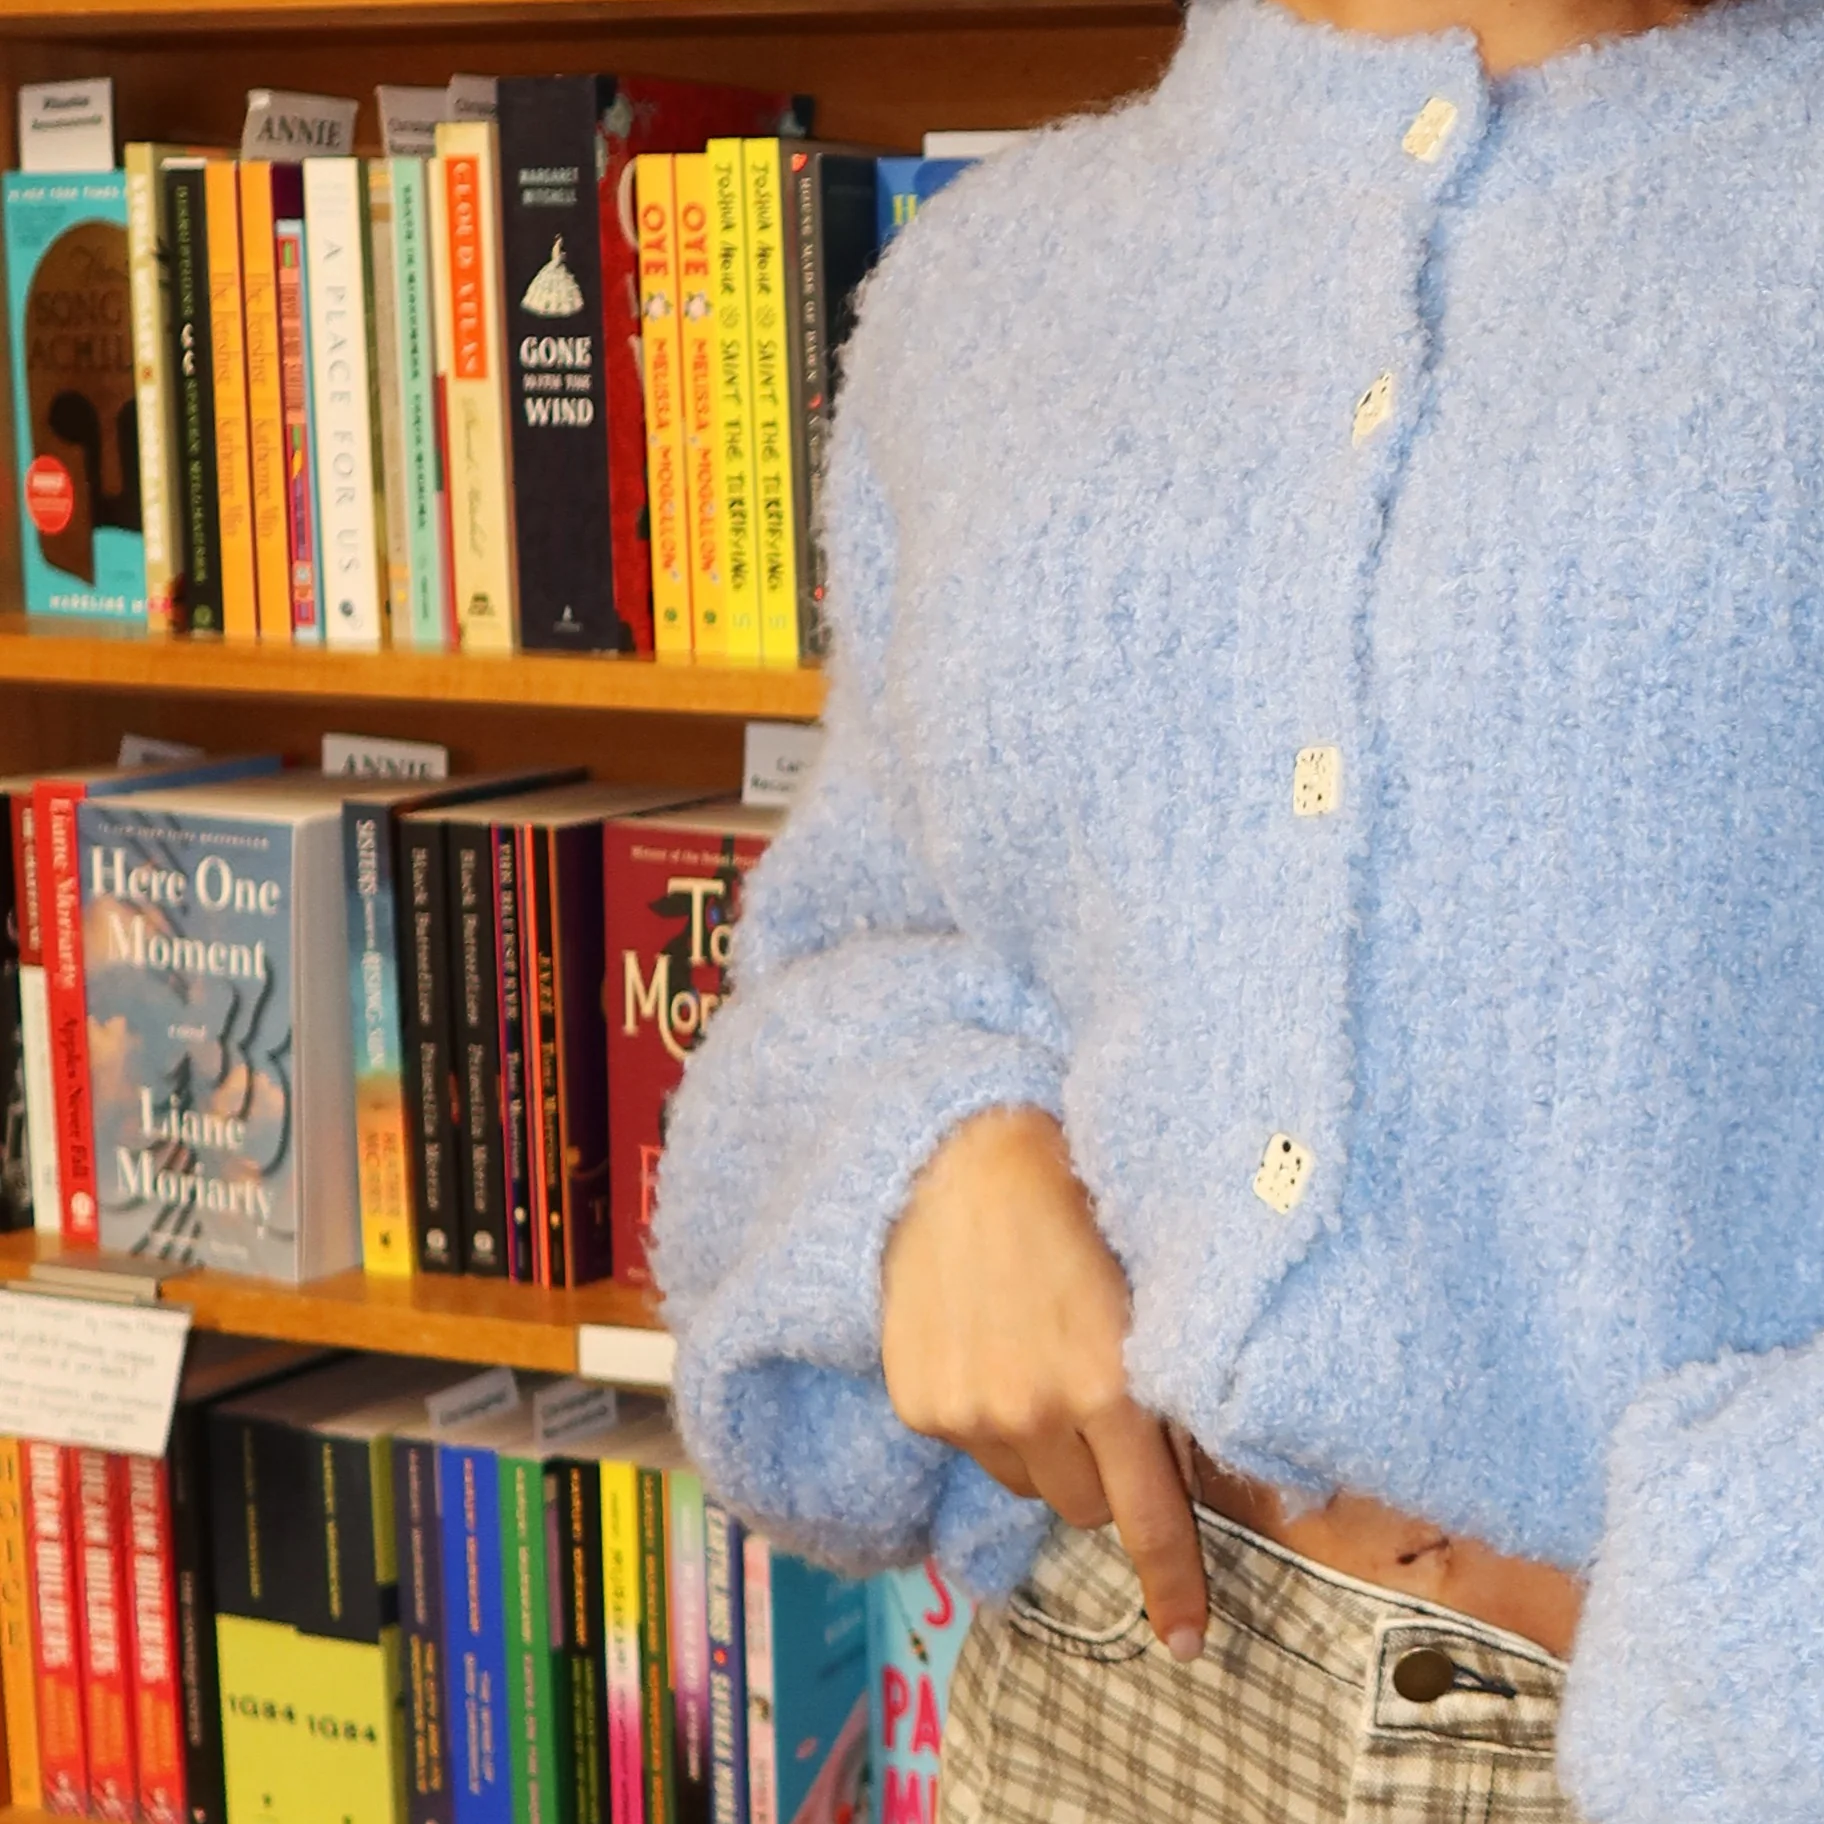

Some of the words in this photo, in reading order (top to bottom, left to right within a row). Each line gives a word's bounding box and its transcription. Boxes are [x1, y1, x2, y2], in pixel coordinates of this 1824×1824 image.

[256, 114, 343, 150] ANNIE
[640, 202, 667, 278] OYE
[519, 336, 592, 369] GONE
[524, 397, 594, 427] WIND
[90, 845, 187, 902] Here
[195, 855, 282, 916] One
[107, 913, 267, 981] Moment
[140, 1085, 247, 1151] Liane
[115, 1146, 273, 1221] Moriarty
[305, 1712, 379, 1748] 1Q84
